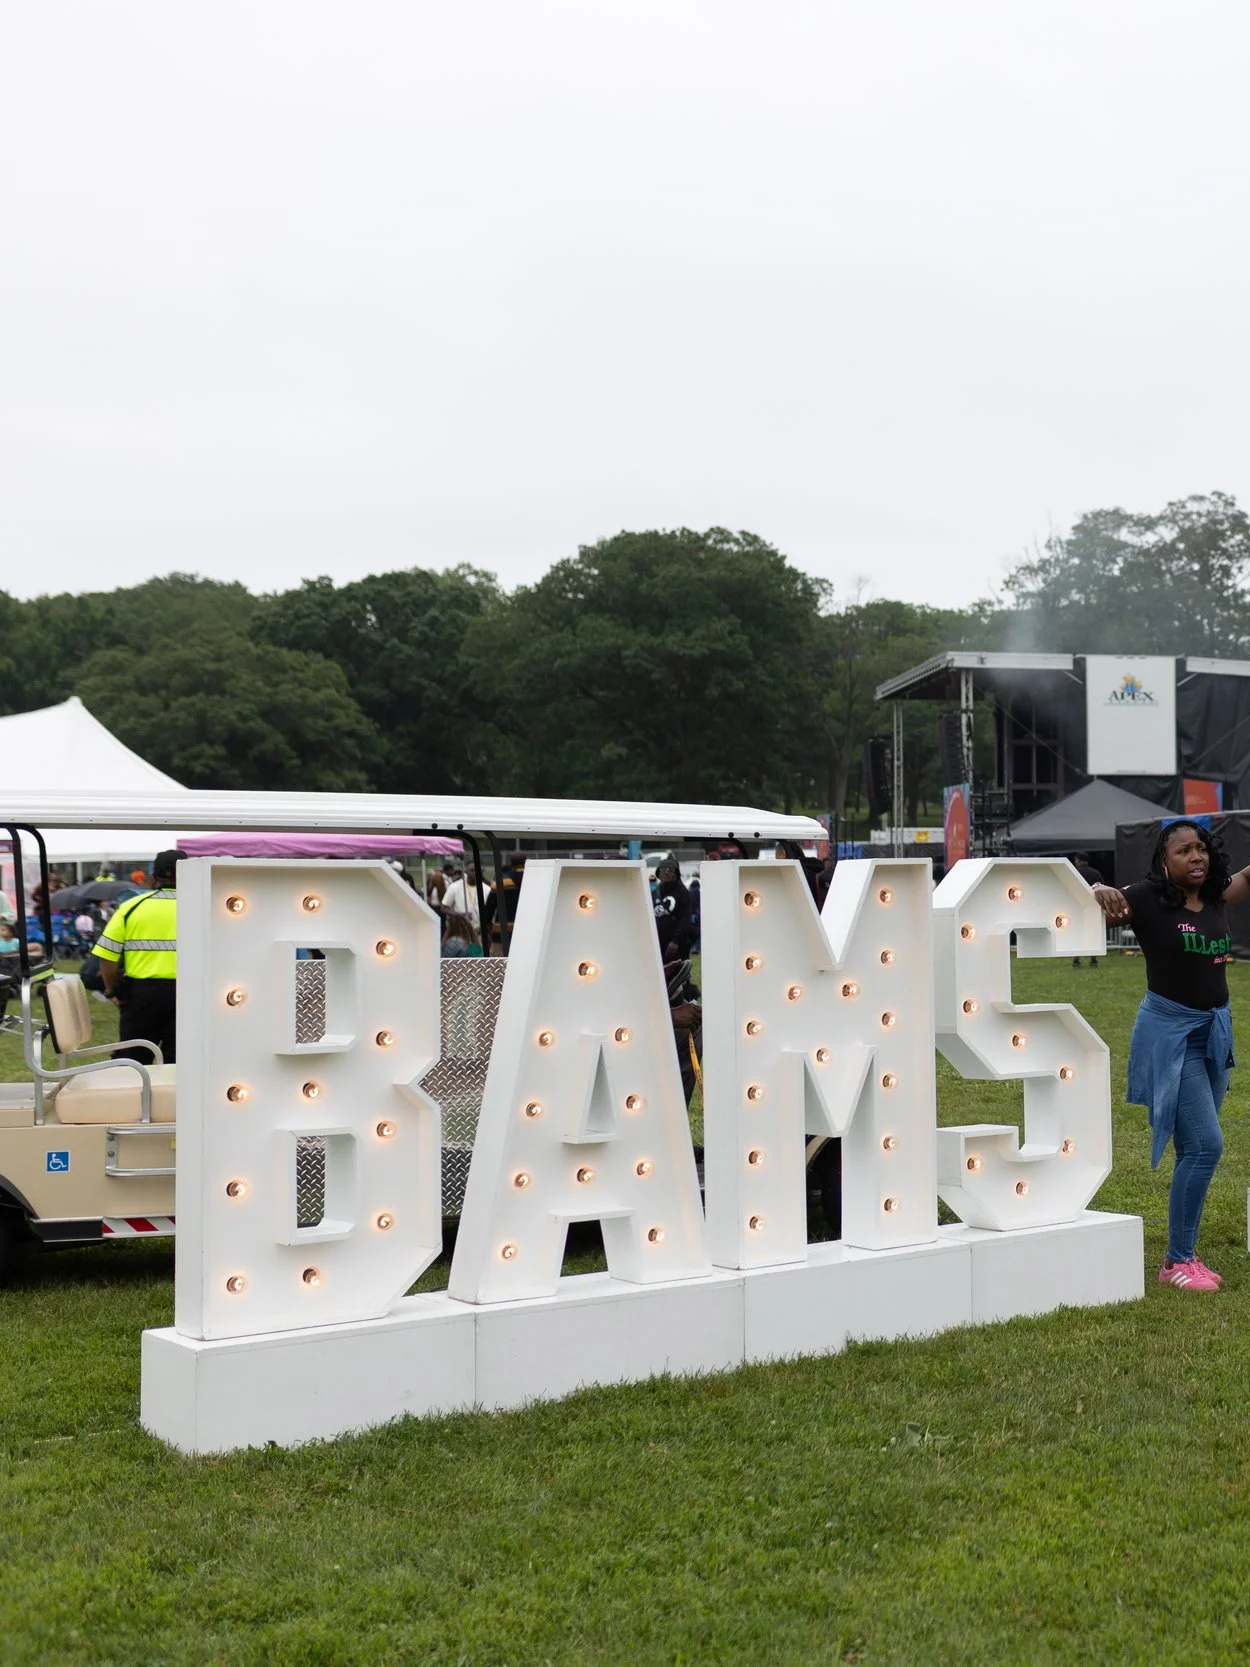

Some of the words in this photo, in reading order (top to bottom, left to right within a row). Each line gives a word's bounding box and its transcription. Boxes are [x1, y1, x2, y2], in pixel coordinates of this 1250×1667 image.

[1108, 690, 1155, 701] APEX
[1178, 923, 1197, 932] The
[175, 857, 1112, 1340] BAMS
